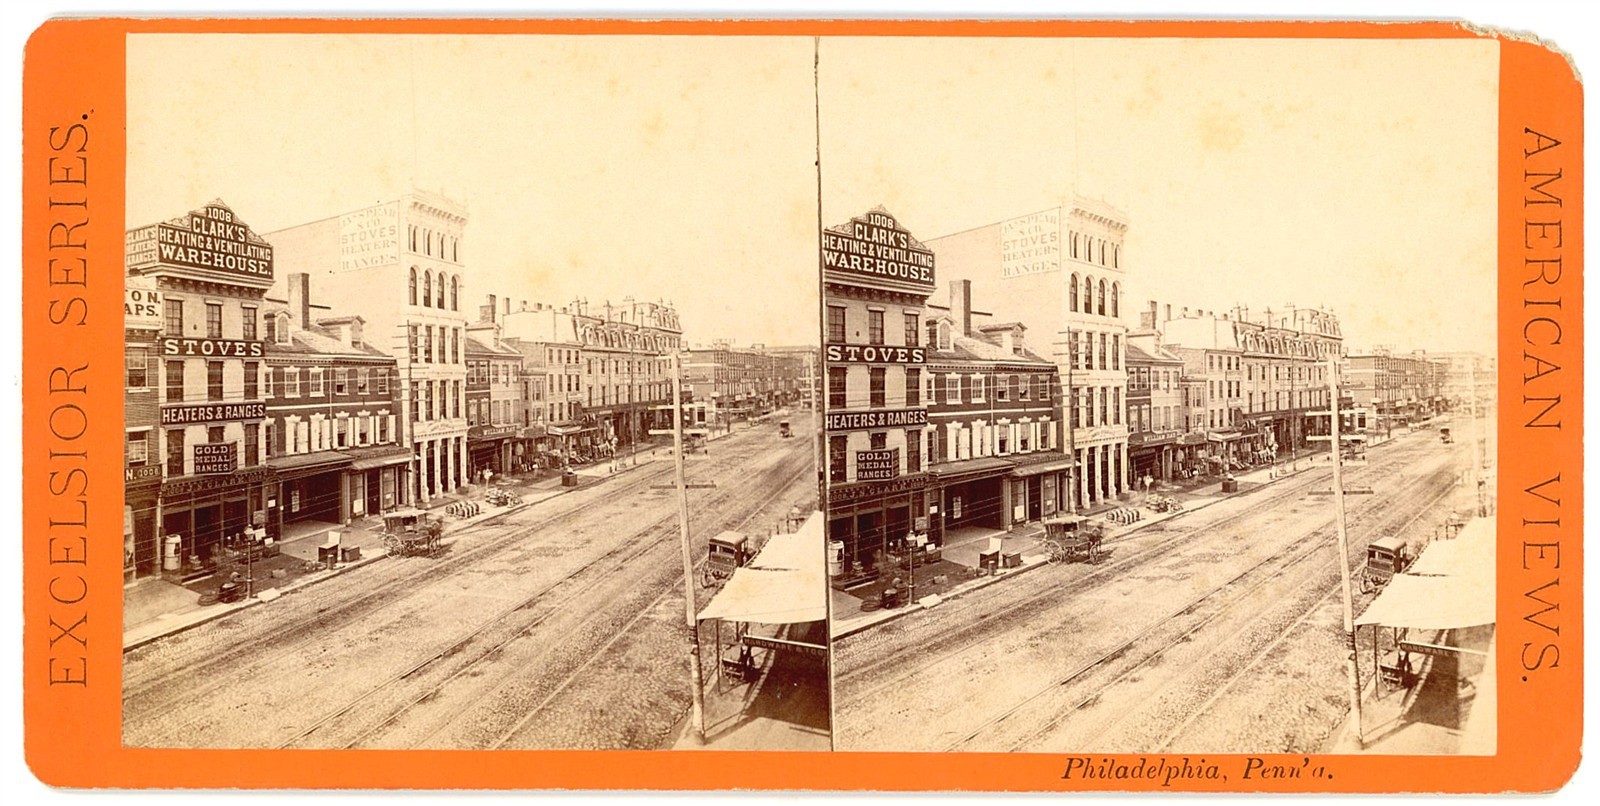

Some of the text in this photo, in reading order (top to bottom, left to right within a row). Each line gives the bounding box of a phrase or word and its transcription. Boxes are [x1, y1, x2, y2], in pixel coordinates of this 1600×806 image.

[207, 207, 232, 222] 1008
[869, 214, 894, 228] 1008
[192, 216, 246, 242] CLARK'S
[341, 225, 397, 244] STOVES
[855, 223, 908, 249] CLARK'S
[159, 226, 271, 261] HEATING & VENTILATING
[341, 239, 397, 255] HEATERS
[1003, 231, 1058, 251] STOVES
[159, 243, 272, 276] WAREHOUSE.
[823, 234, 933, 268] HEATING & VENTILATING
[1003, 245, 1058, 262] HEATERS
[823, 249, 934, 282] WAREHOUSE.
[1003, 260, 1058, 276] RANGES
[125, 289, 161, 304] ON.
[164, 339, 263, 357] STOVES
[827, 345, 924, 363] STOVES
[49, 114, 90, 688] EXCELSIOR SERIES.
[1521, 126, 1563, 682] AMERICAN VIEWS.
[162, 404, 265, 423] HEATERS & RANGES.
[826, 410, 928, 429] HEATERS & RANGES.
[195, 445, 229, 455] GOLD
[195, 454, 230, 464] MEDAL
[857, 452, 891, 461] GOLD
[195, 463, 230, 472] RANGES.
[857, 461, 892, 470] MEDAL
[857, 470, 892, 478] RANGES.
[743, 638, 793, 651] HARDWARE
[1401, 643, 1450, 657] HARDWARE
[1060, 757, 1228, 787] Philadelphia,
